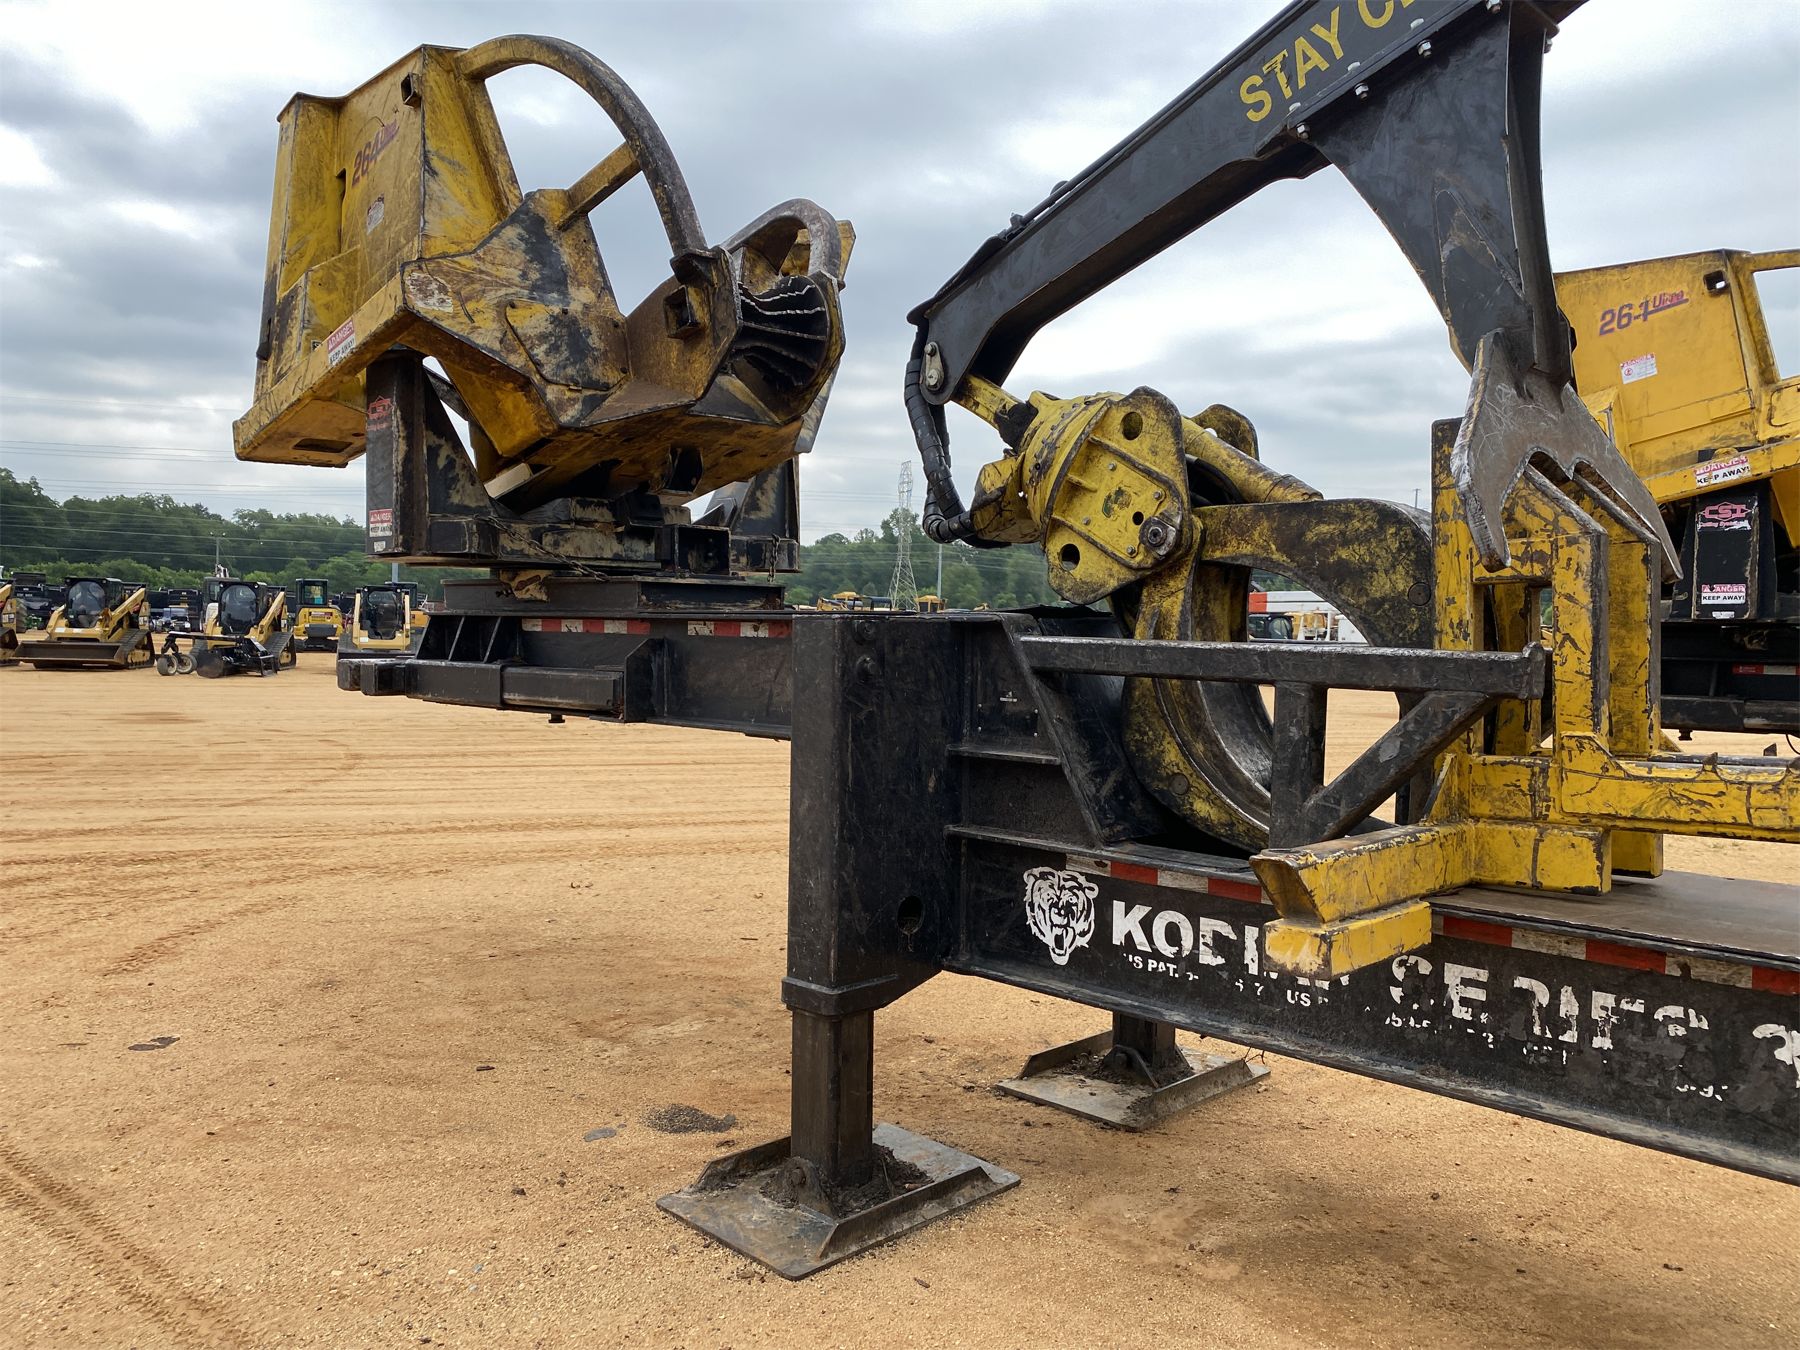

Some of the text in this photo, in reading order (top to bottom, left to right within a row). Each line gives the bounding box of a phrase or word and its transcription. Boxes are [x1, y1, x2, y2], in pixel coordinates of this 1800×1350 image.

[1239, 7, 1345, 122] STAY
[1697, 474, 1719, 484] KEP
[1704, 504, 1746, 518] CSI
[1713, 584, 1746, 593] ANGER
[1112, 900, 1350, 990] KODI
[1148, 959, 1179, 978] PAT.
